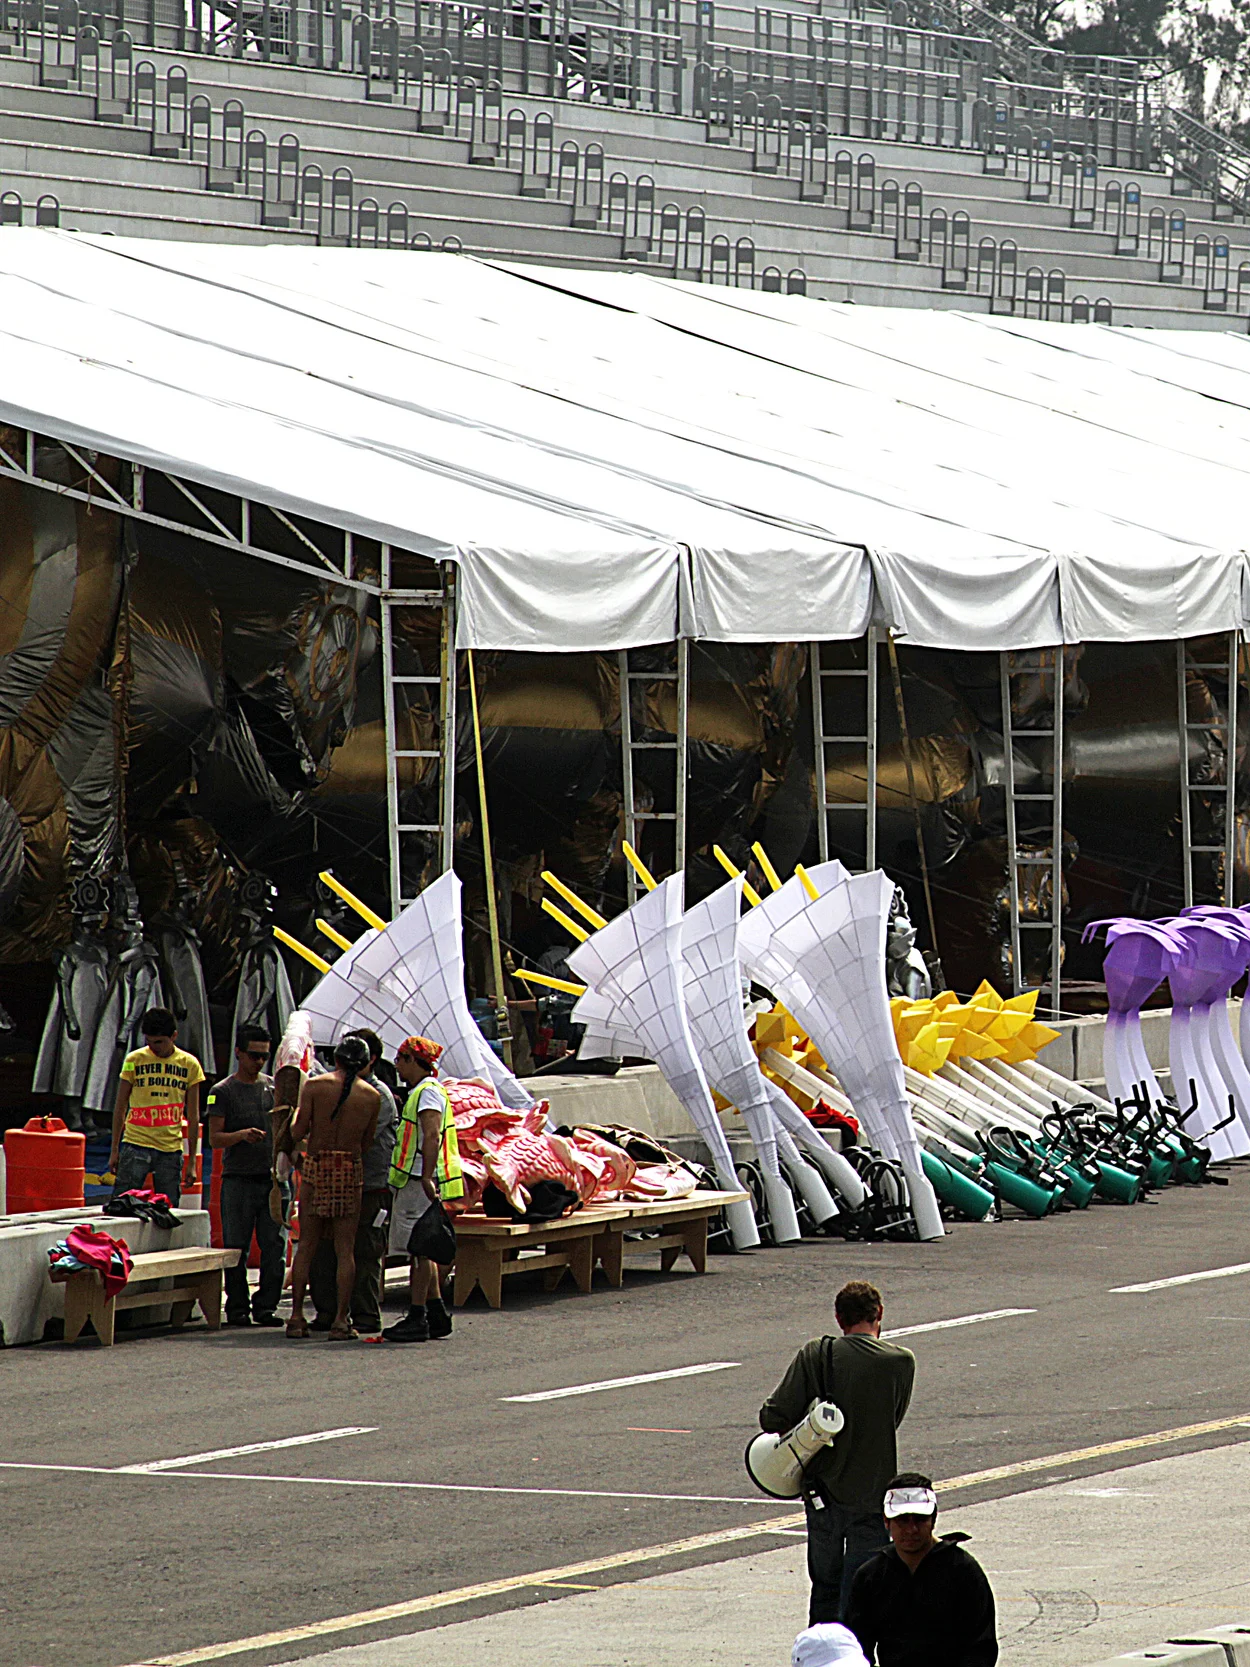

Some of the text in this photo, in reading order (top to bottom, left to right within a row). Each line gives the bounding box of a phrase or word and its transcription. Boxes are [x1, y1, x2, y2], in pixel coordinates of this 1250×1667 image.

[996, 113, 1005, 121] 10
[135, 1063, 188, 1078] NEVER MIND
